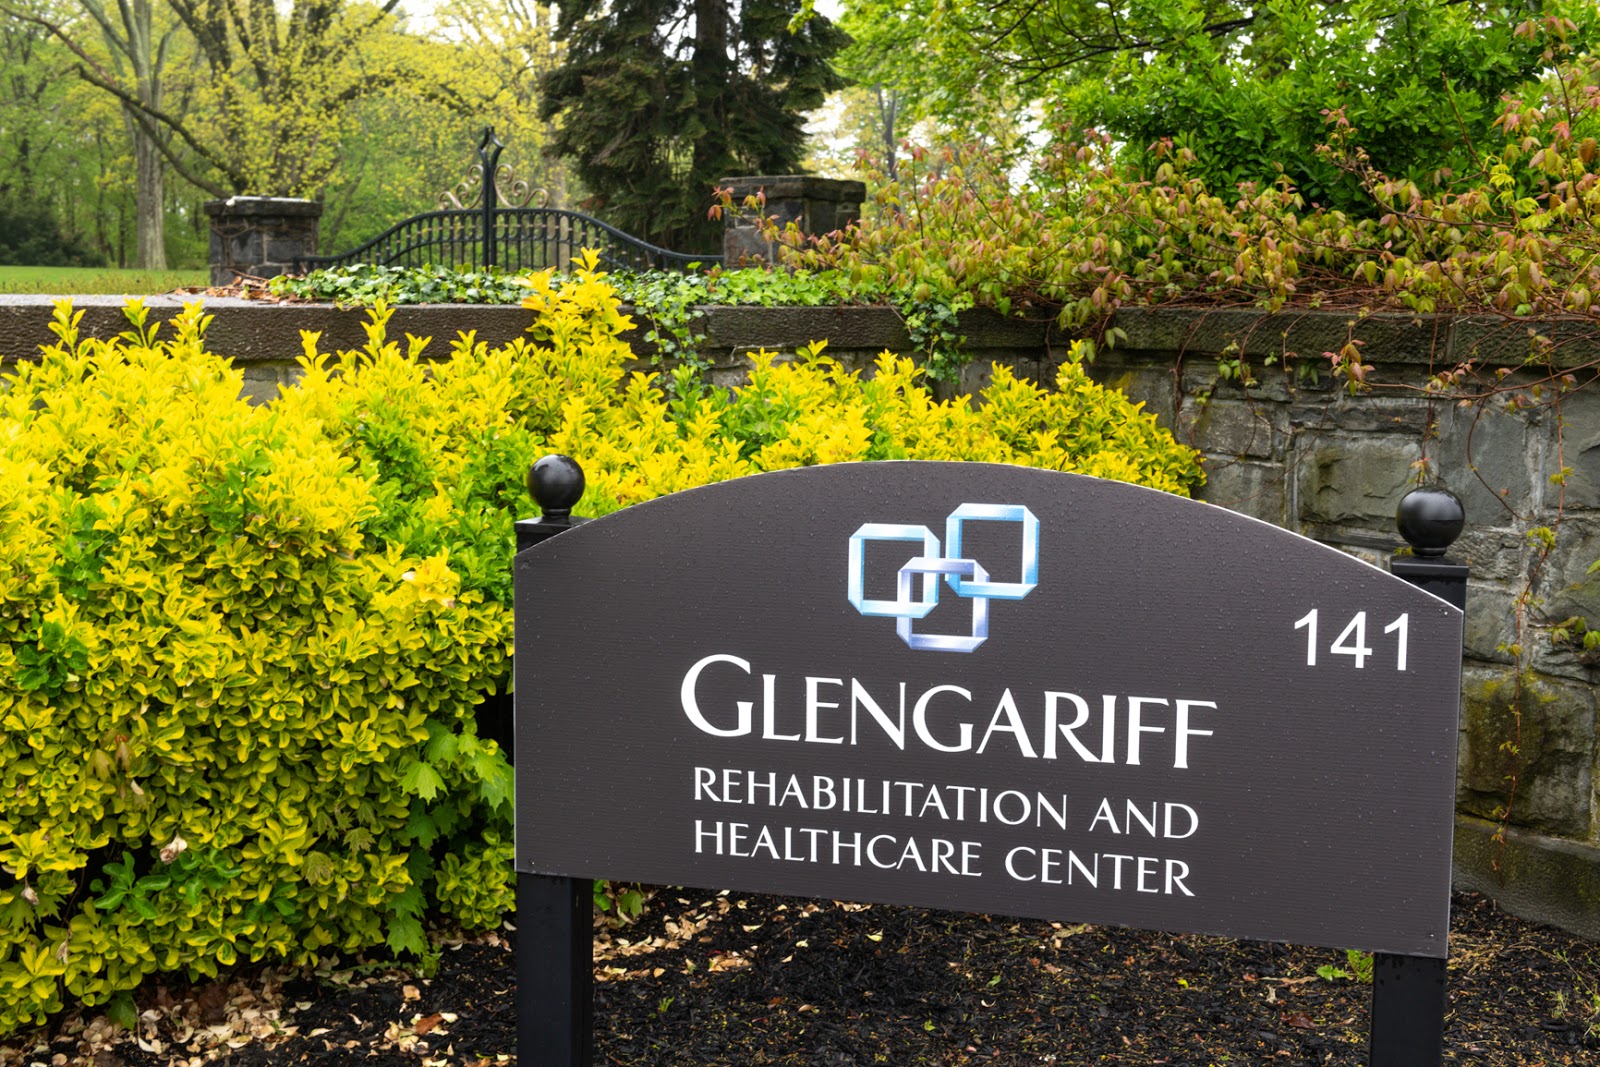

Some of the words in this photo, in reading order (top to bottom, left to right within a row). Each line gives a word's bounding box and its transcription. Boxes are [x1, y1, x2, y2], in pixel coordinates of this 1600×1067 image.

[1293, 608, 1409, 672] 141
[680, 653, 1218, 769] GLENGARIFF
[694, 766, 1067, 831] REHABILITATION
[1088, 797, 1199, 839] AND
[694, 819, 983, 877] HEALTHCARE
[1004, 846, 1196, 898] CENTER
